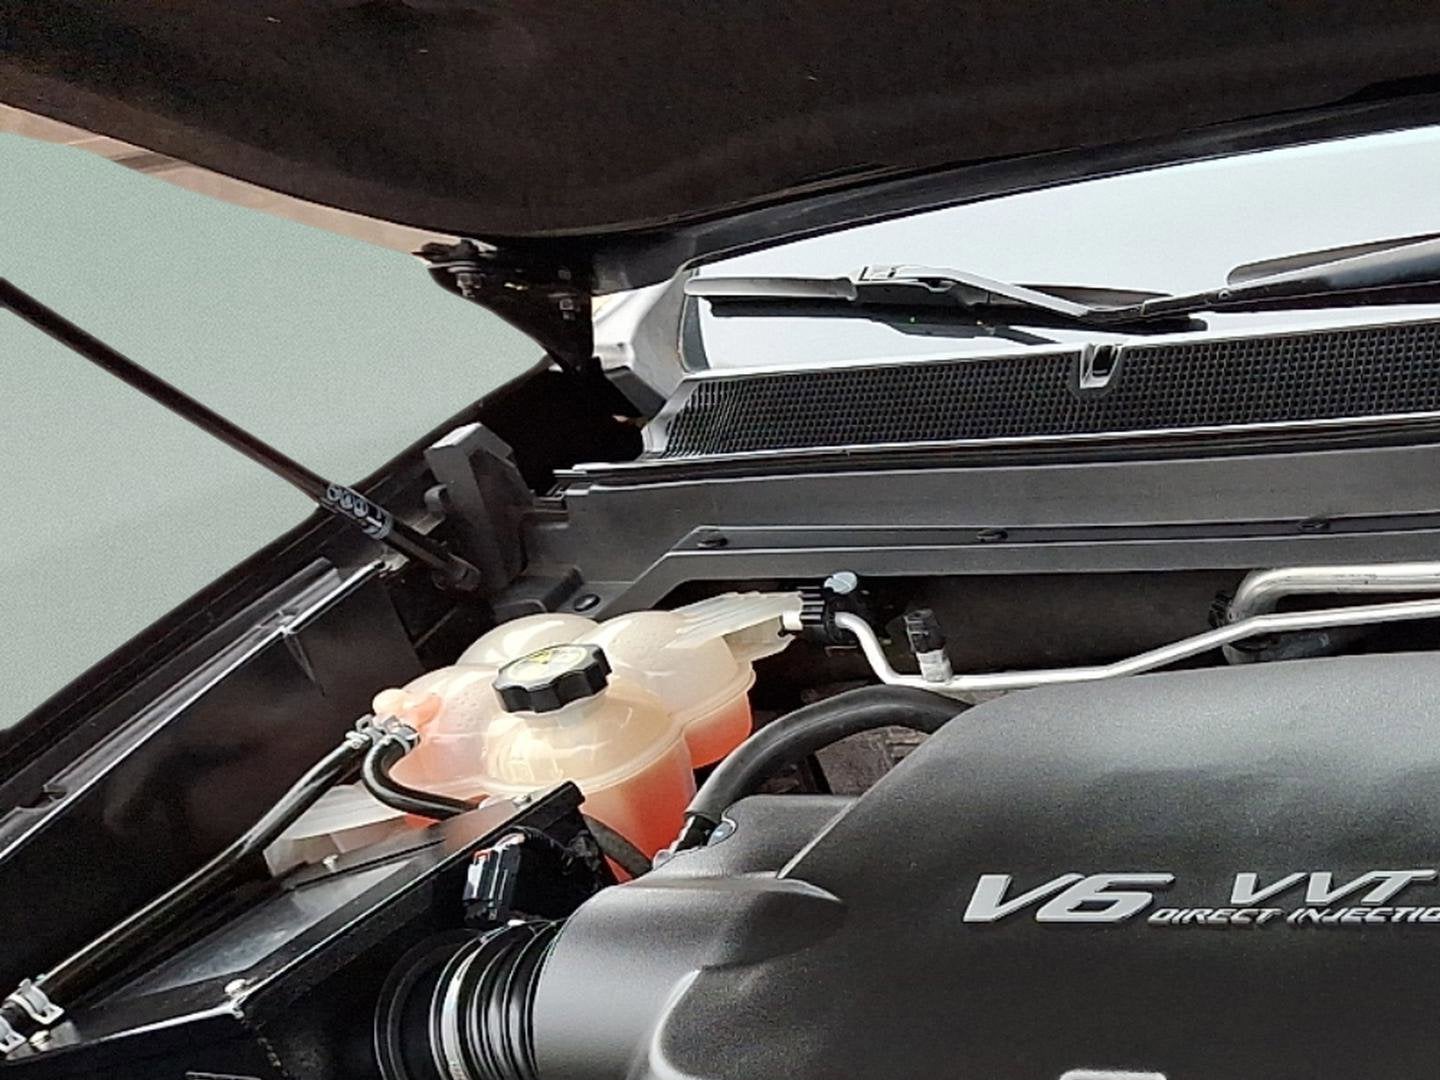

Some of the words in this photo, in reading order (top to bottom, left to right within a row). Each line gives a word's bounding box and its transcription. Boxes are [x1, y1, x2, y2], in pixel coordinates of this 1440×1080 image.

[963, 872, 1175, 923] V6
[1230, 869, 1438, 905] VVT
[1147, 906, 1283, 925] DIRECT
